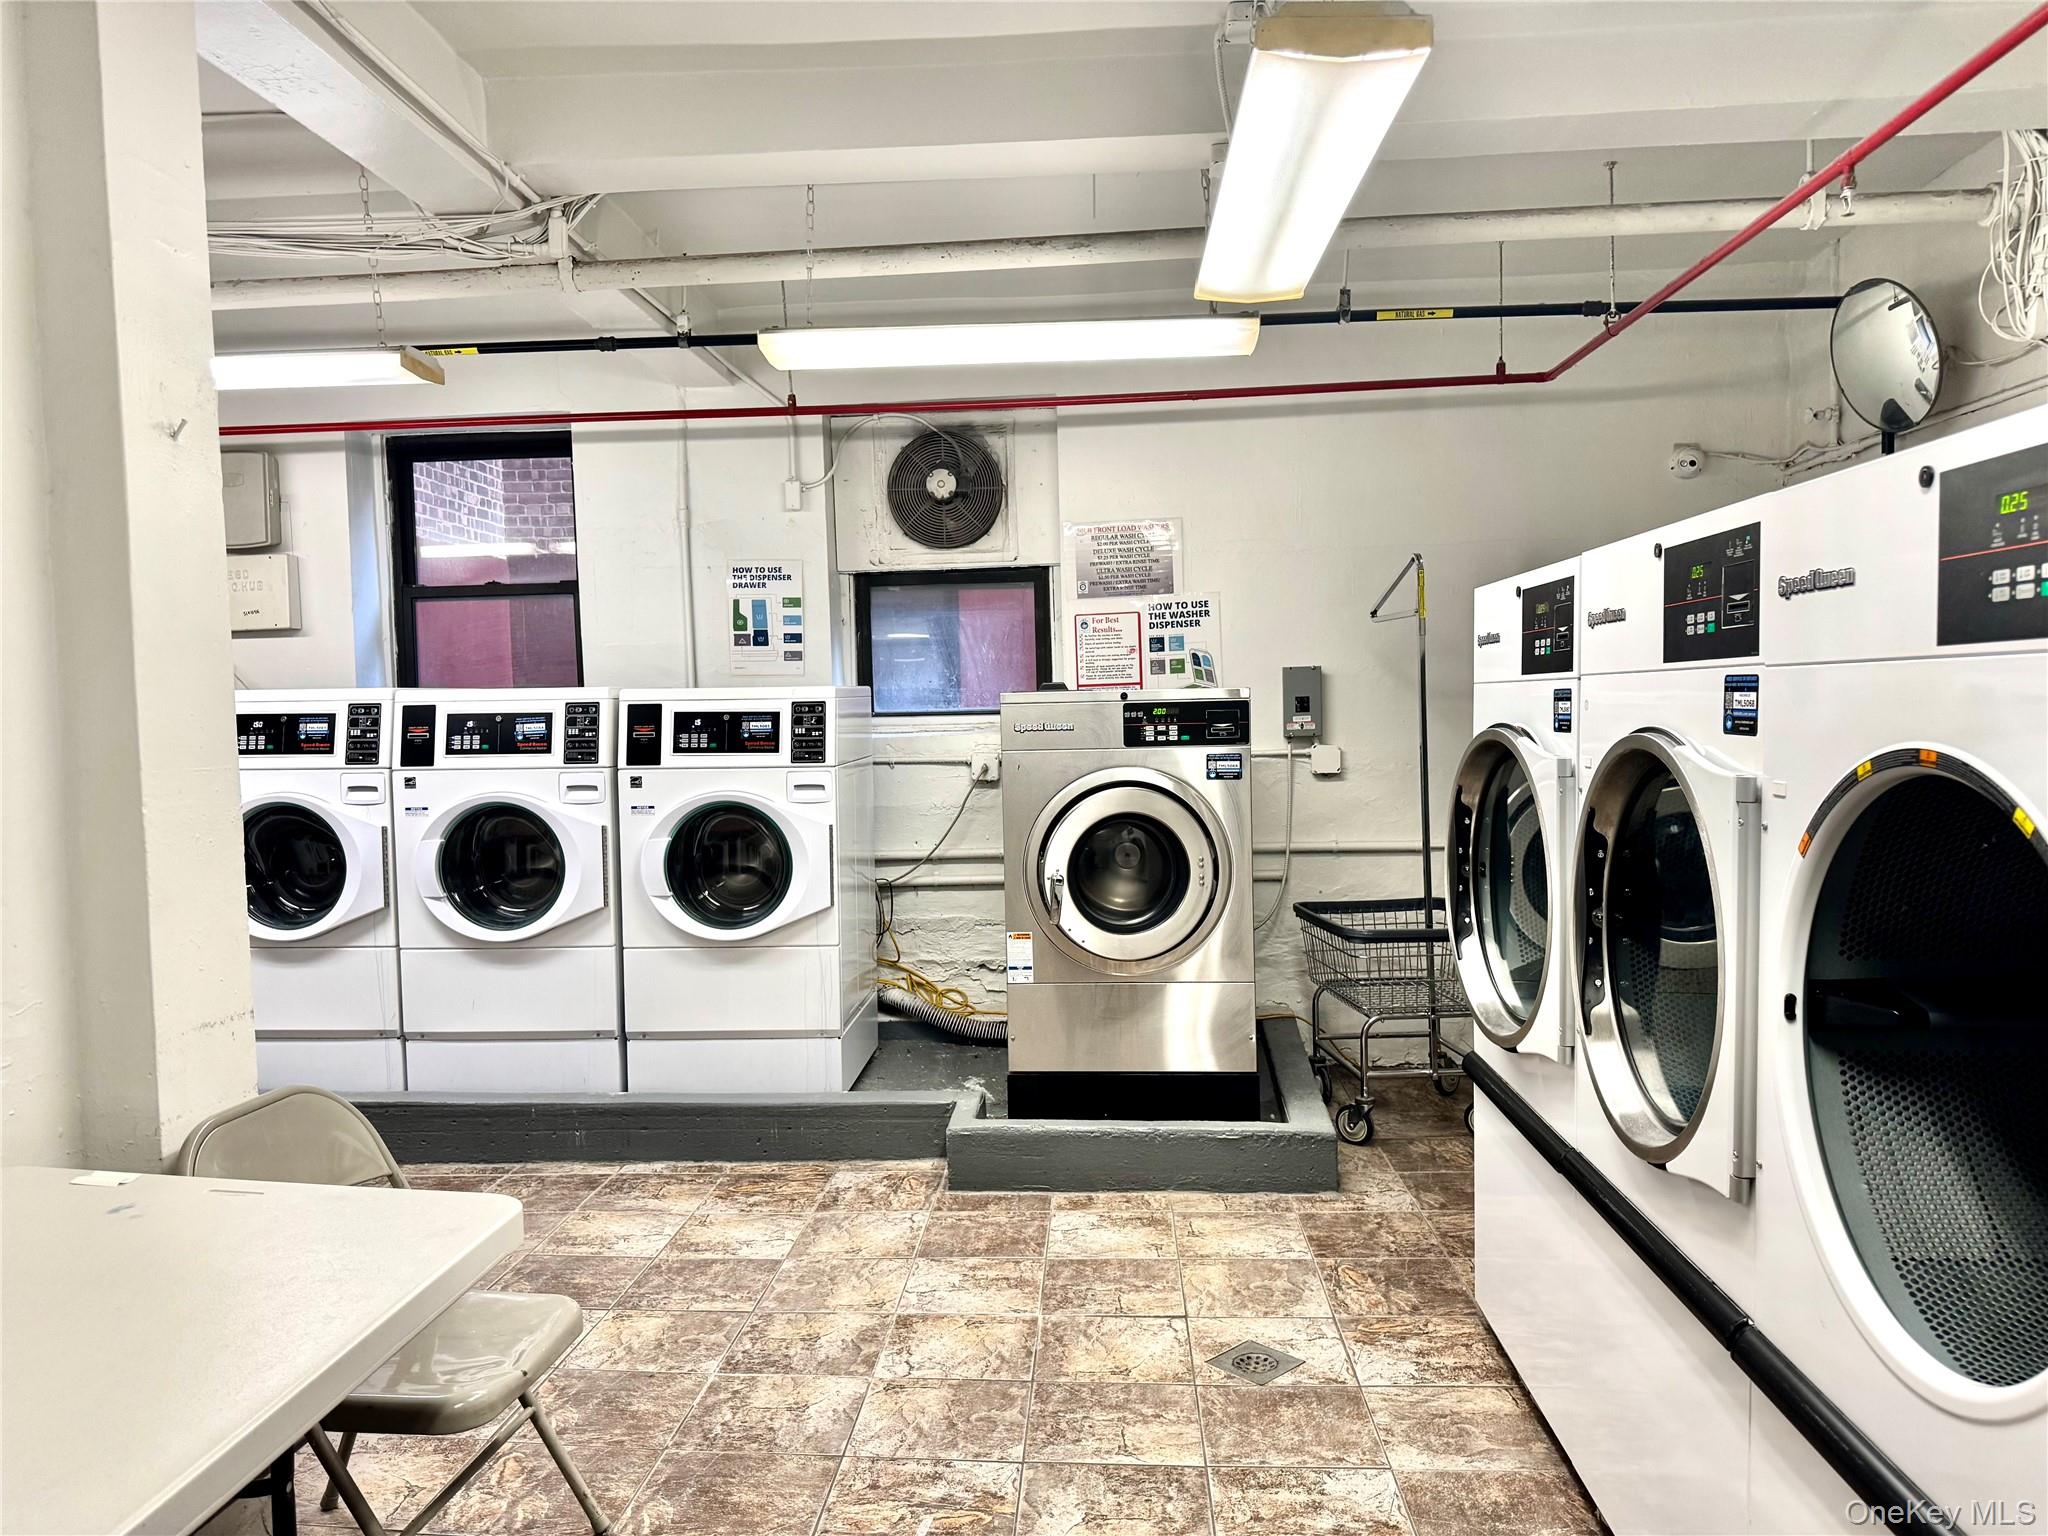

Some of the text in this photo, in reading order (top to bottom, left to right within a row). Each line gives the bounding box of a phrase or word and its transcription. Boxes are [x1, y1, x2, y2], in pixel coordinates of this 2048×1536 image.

[732, 566, 783, 574] HOW TO USE
[1778, 567, 1856, 601] Speed Queen
[1148, 600, 1209, 611] HOW TO USE
[1148, 609, 1211, 620] THE WASHER
[1092, 616, 1119, 625] For Best
[1149, 619, 1201, 630] DISPENSER
[1013, 722, 1075, 734] Speed Queen
